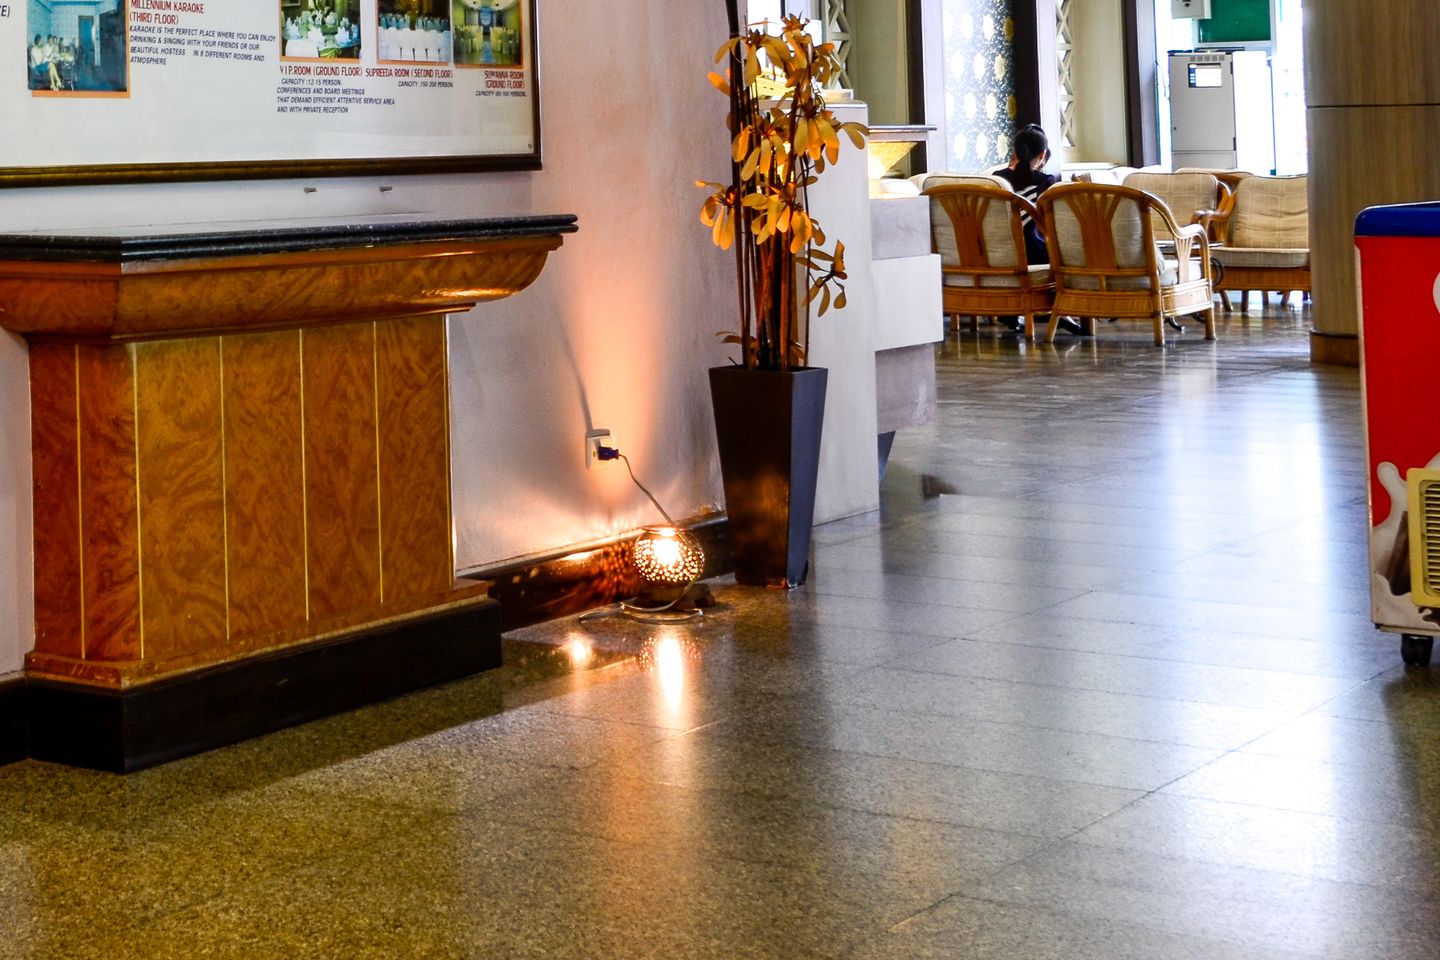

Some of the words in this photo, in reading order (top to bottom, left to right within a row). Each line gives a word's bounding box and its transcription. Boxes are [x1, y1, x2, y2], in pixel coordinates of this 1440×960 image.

[173, 1, 204, 14] KARAOKE
[130, 11, 152, 24] (THIRD
[154, 13, 179, 25] FLOOR)
